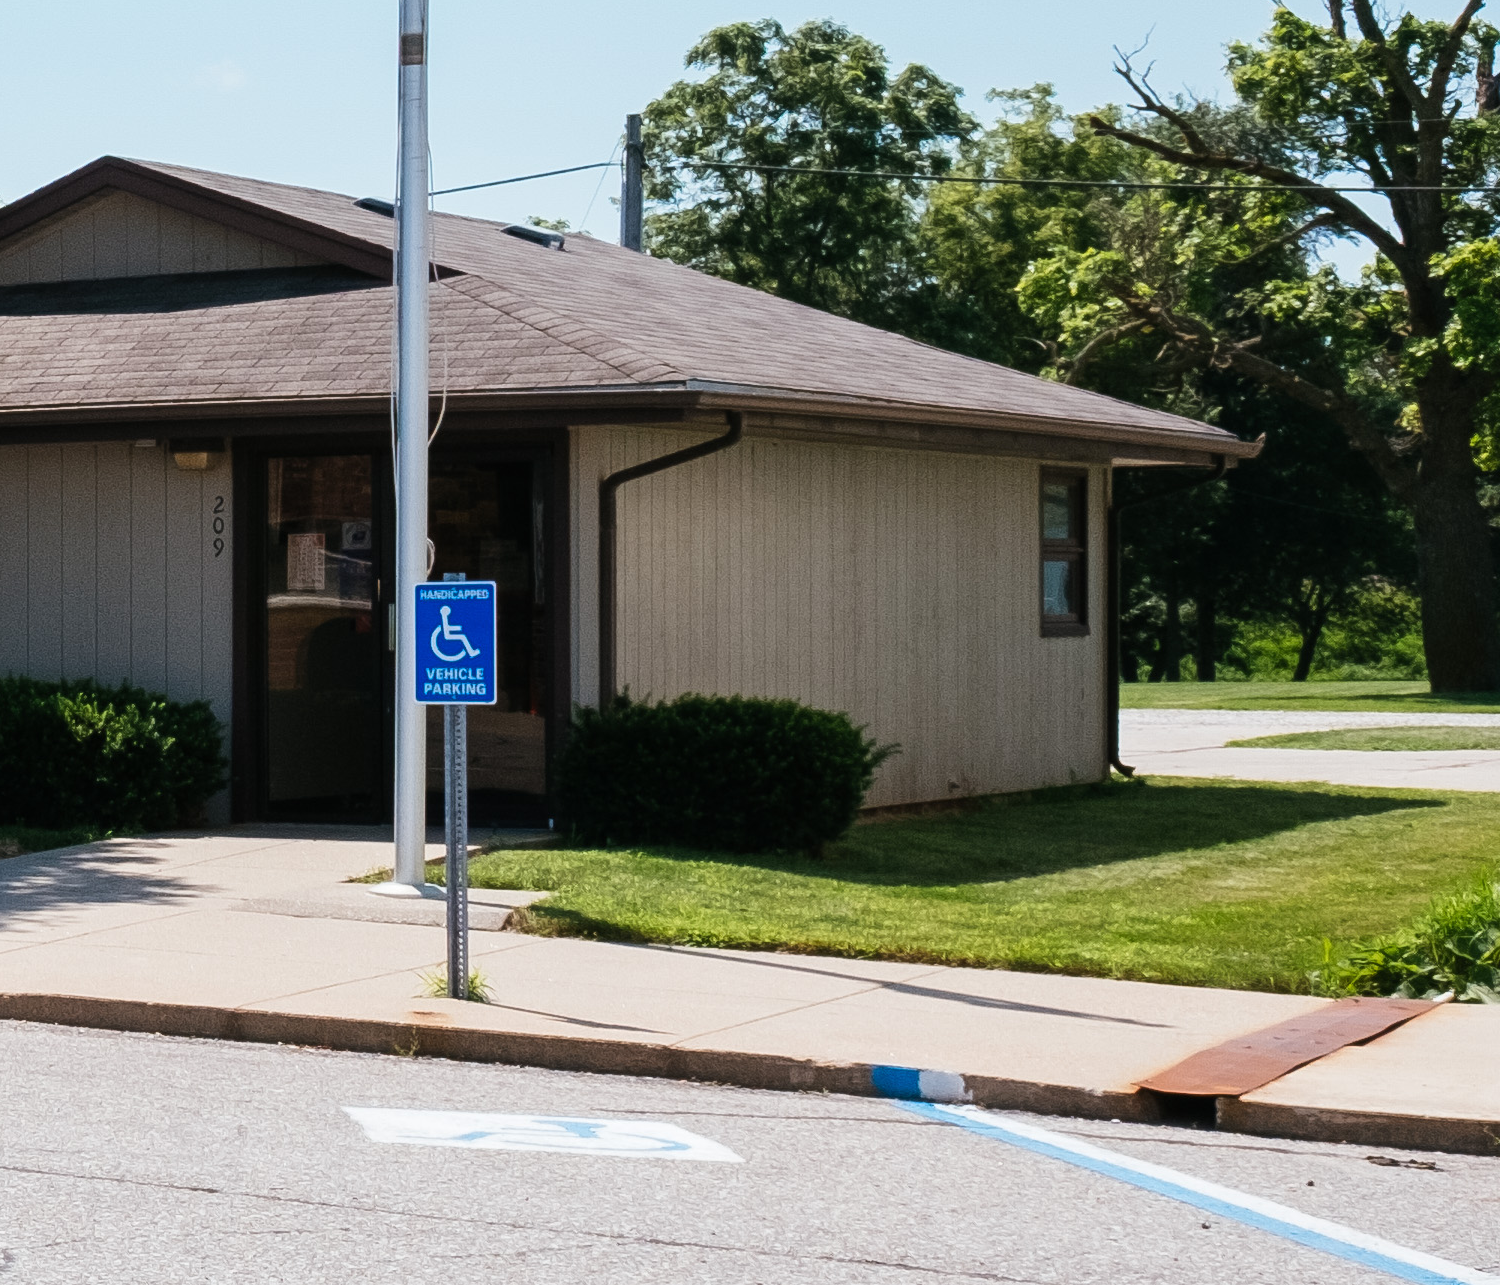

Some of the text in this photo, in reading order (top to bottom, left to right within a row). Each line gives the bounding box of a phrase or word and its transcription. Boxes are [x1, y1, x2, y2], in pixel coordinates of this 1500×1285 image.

[213, 496, 225, 557] 209
[420, 588, 490, 600] HANDICAPPED
[426, 667, 484, 680] VEHICLE
[424, 683, 487, 695] PARKING
